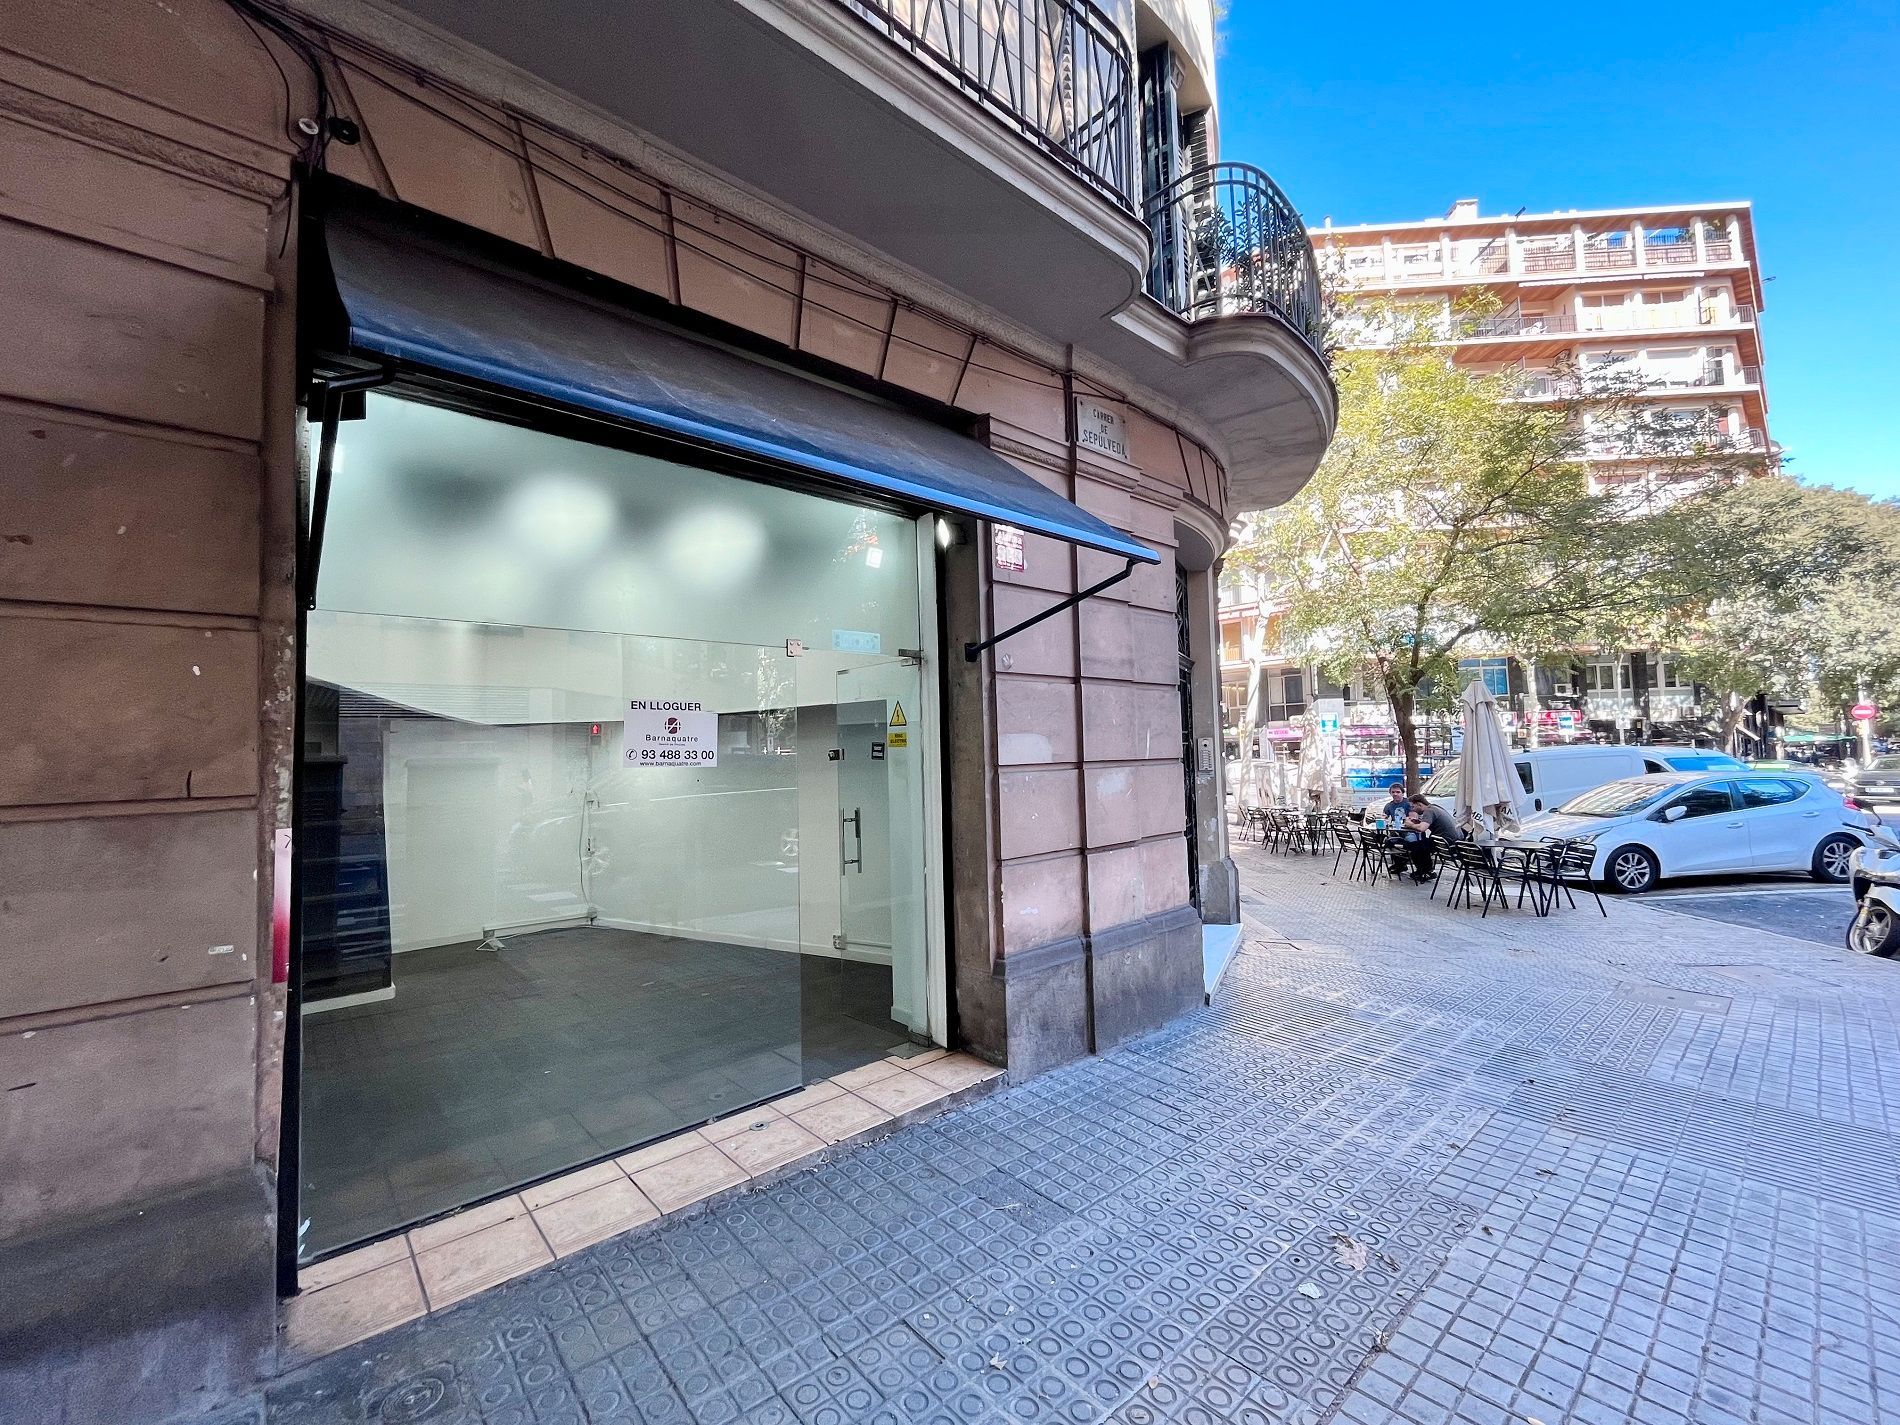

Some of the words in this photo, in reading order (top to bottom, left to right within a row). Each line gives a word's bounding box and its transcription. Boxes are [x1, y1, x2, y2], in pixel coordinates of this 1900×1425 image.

[1093, 409, 1114, 424] CARRER
[1101, 424, 1108, 434] DE
[631, 700, 646, 710] EN
[650, 701, 702, 711] LLOGUER
[645, 734, 699, 743] Barnaquatre
[641, 749, 656, 760] 93
[659, 750, 681, 760] 488
[684, 750, 698, 760] 33
[701, 750, 715, 760] 00
